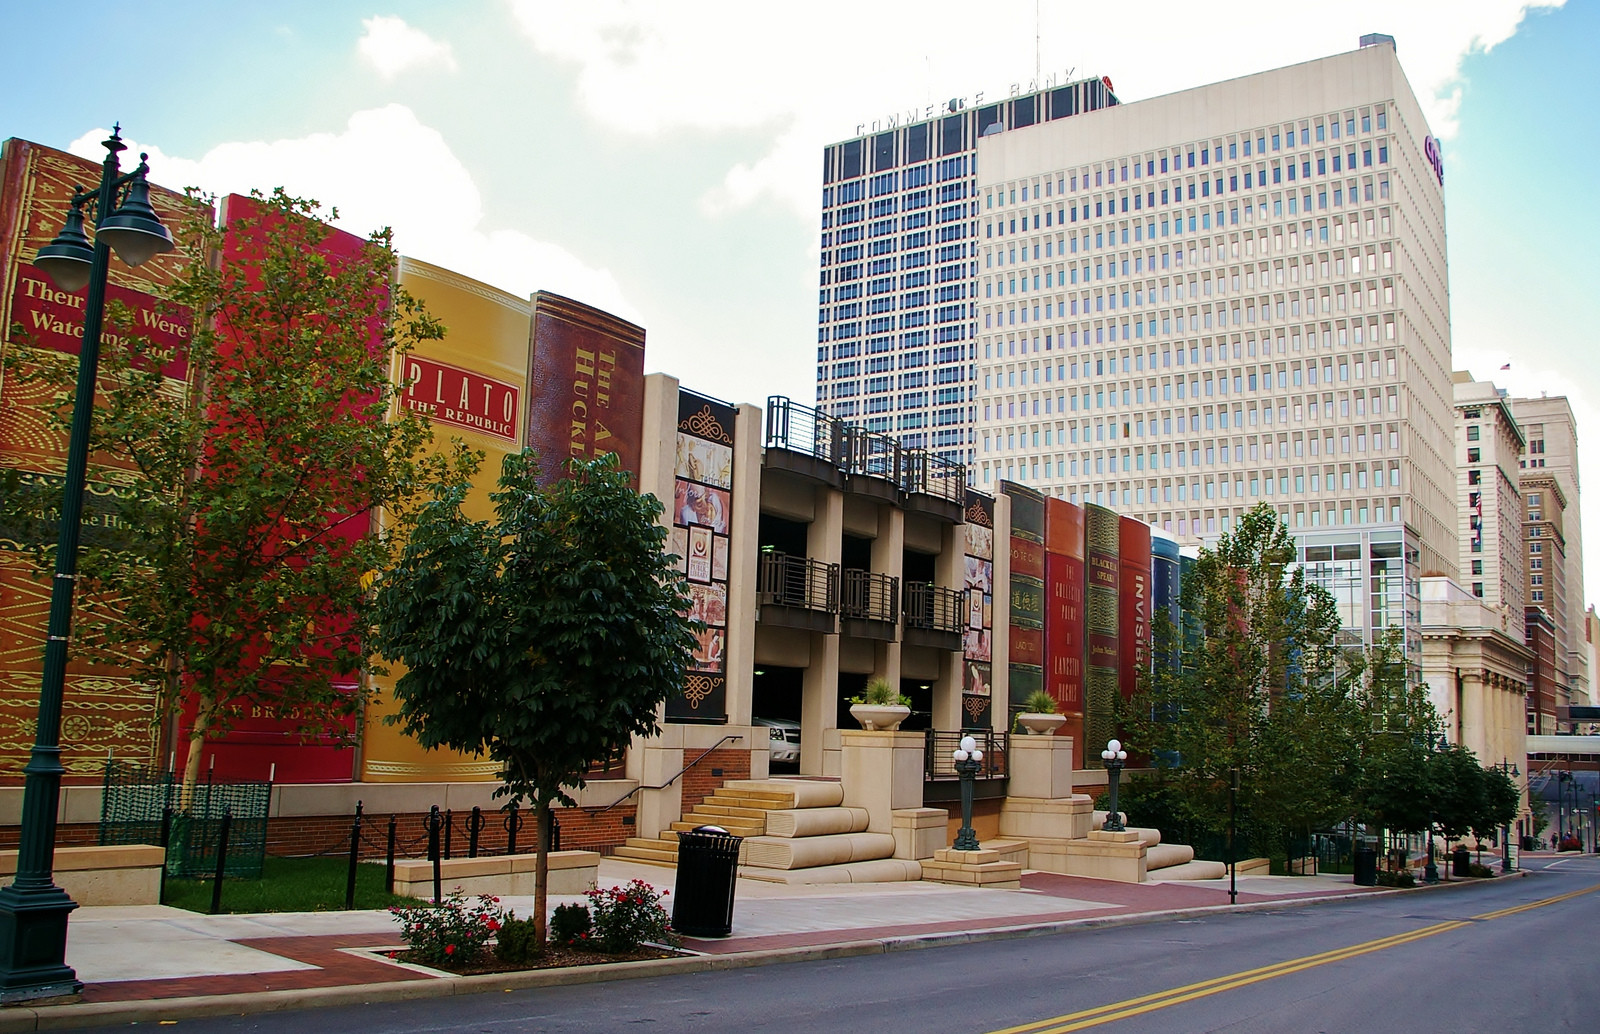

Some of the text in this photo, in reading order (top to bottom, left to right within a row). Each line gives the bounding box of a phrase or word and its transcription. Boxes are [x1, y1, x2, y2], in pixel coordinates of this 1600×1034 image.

[856, 67, 1076, 136] COMMERCE BANK
[22, 277, 85, 309] Their
[141, 309, 188, 338] Were
[30, 309, 131, 350] Watcing
[407, 399, 511, 435] THE REPUBLIC
[408, 362, 513, 423] PLATO
[1091, 557, 1110, 569] BLACK
